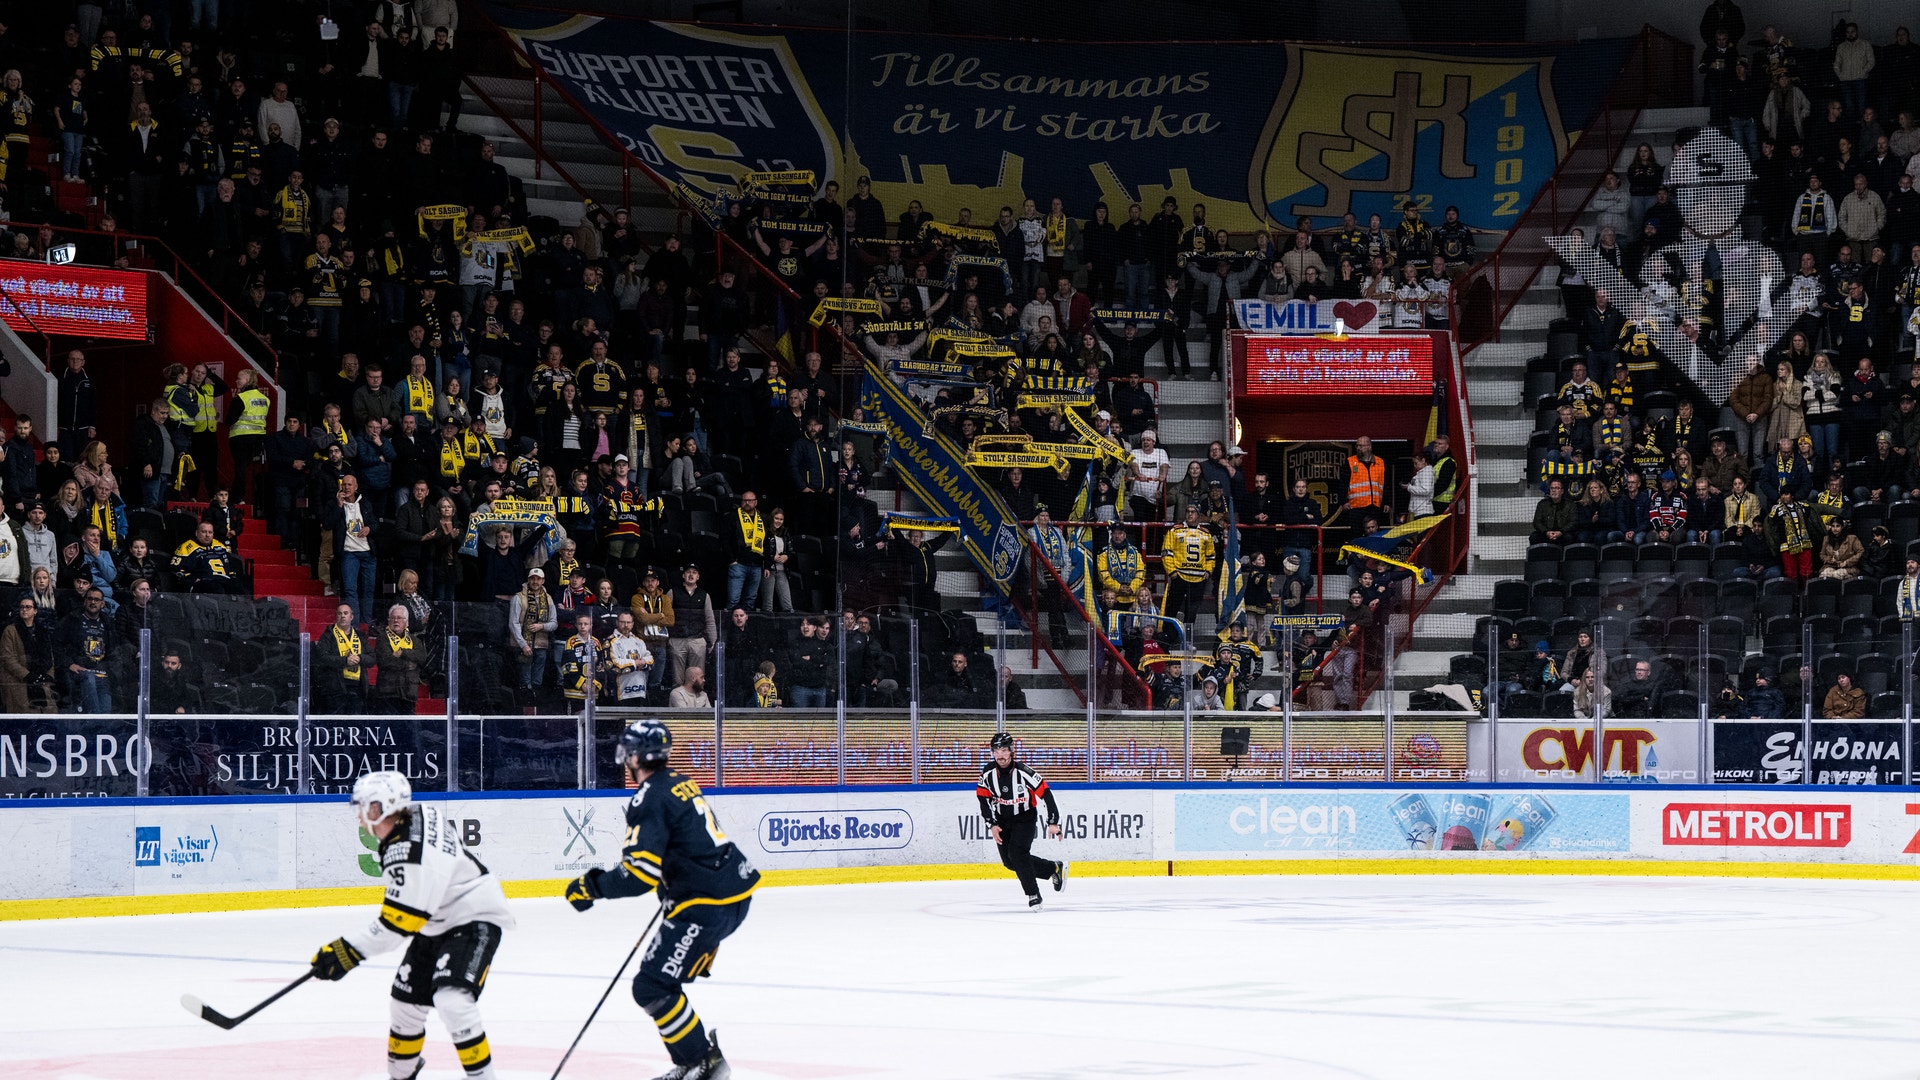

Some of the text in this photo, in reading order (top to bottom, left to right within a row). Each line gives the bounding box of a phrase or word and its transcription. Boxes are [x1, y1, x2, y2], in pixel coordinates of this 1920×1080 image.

[532, 41, 783, 95] SUPPORTER
[870, 51, 1211, 100] Tillsammans
[573, 80, 776, 129] KLUBBEN
[893, 102, 1222, 142] är vi starka
[761, 220, 777, 229] KOM
[779, 221, 797, 231] IGEN
[1097, 310, 1113, 318] KOM
[1115, 310, 1134, 319] IGEN
[1241, 303, 1331, 329] EMIL
[592, 373, 611, 391] S
[982, 454, 1007, 462] STOLT
[1289, 450, 1346, 467] SUPPORTER
[1295, 464, 1341, 481] KLUBBEN
[1328, 493, 1339, 505] 13
[1186, 543, 1200, 563] S
[1521, 727, 1658, 777] CWT
[217, 752, 440, 790] SILJENDAHLS
[1229, 797, 1356, 836] clean
[1392, 799, 1425, 826] clean
[1442, 798, 1486, 821] clean
[1512, 795, 1546, 828] clean
[768, 816, 903, 847] Björcks Resor
[1094, 809, 1144, 839] HÄR?
[1669, 810, 1845, 841] METROLIT
[136, 841, 160, 861] LT
[177, 836, 210, 850] Visar
[164, 849, 205, 867] vägen.
